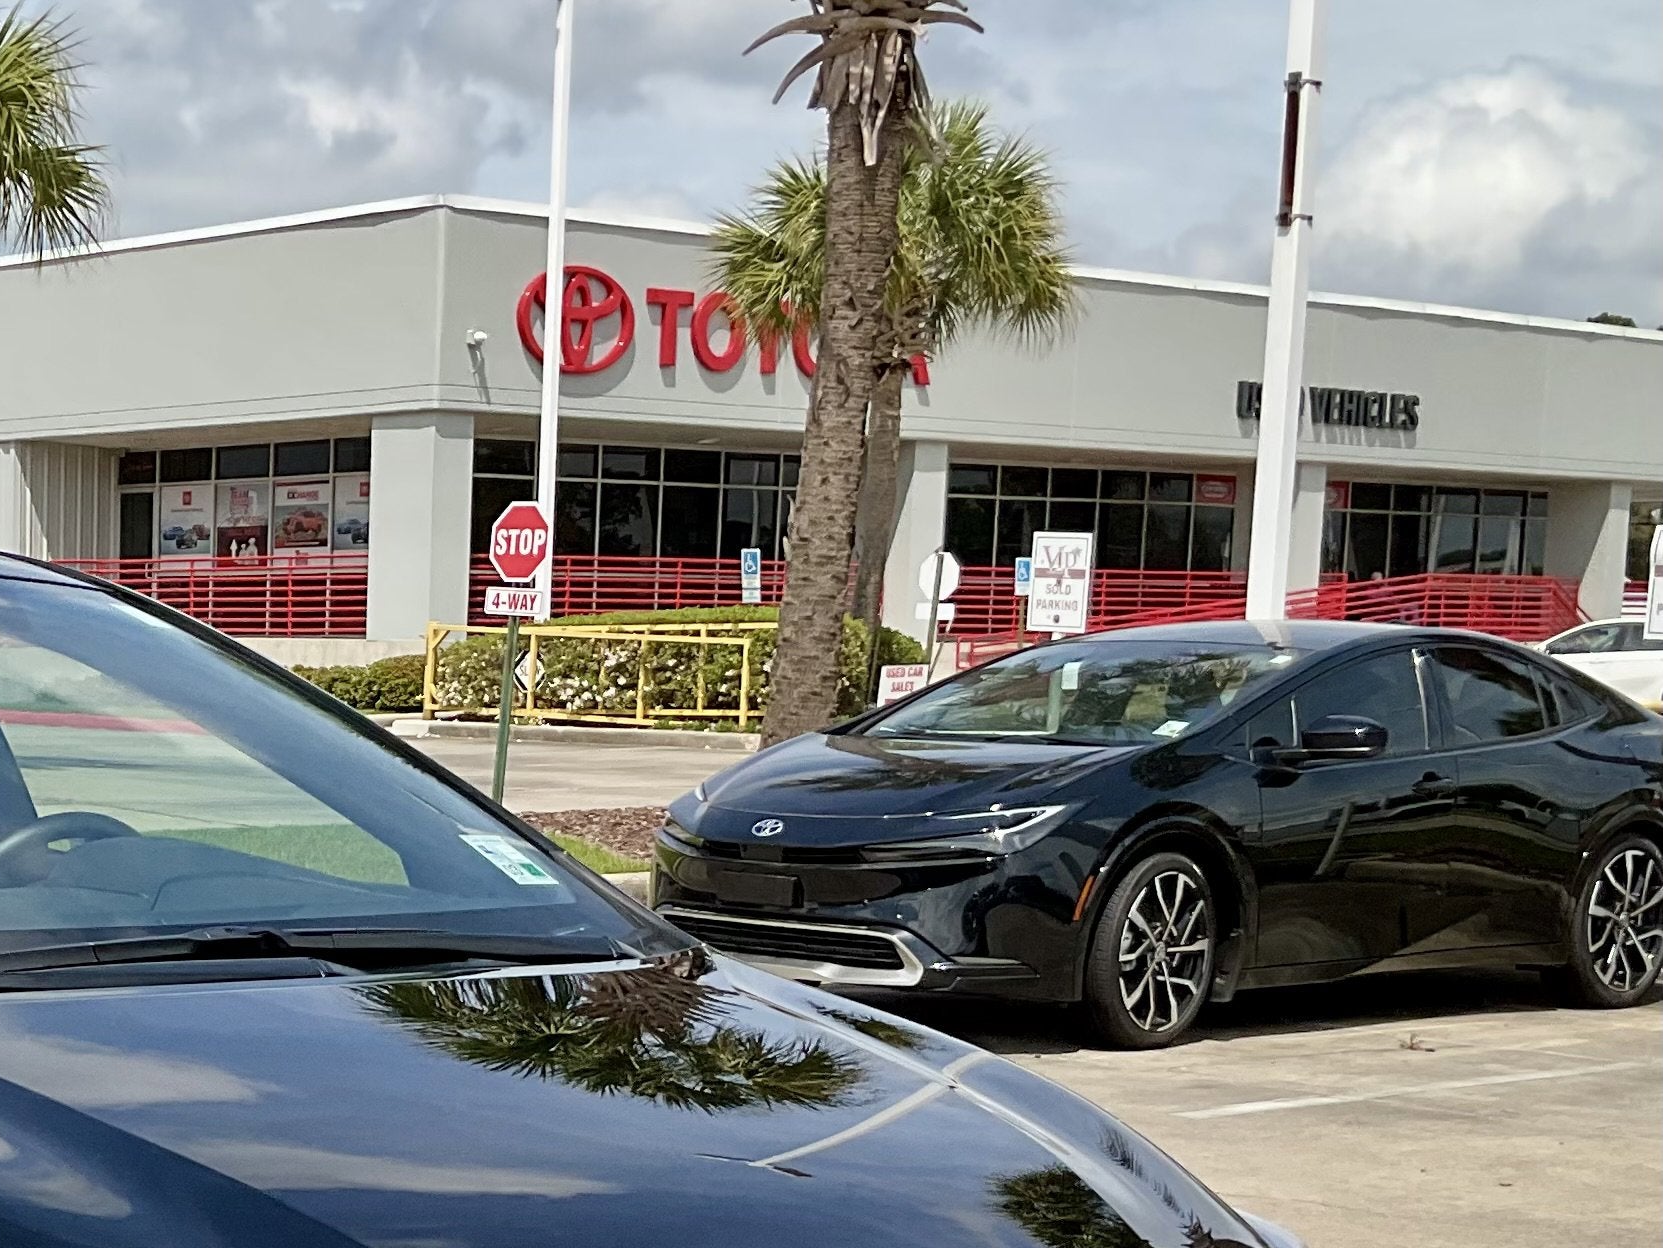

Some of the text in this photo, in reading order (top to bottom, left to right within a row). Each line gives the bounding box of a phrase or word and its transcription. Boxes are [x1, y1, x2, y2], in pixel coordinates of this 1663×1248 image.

[1309, 386, 1419, 430] VEHICLES
[495, 528, 546, 556] STOP
[1045, 583, 1072, 596] SOLD
[492, 592, 537, 611] 4-WAY
[1036, 598, 1078, 612] PARKING
[886, 666, 924, 678] USED CAR
[890, 681, 914, 693] SALES
